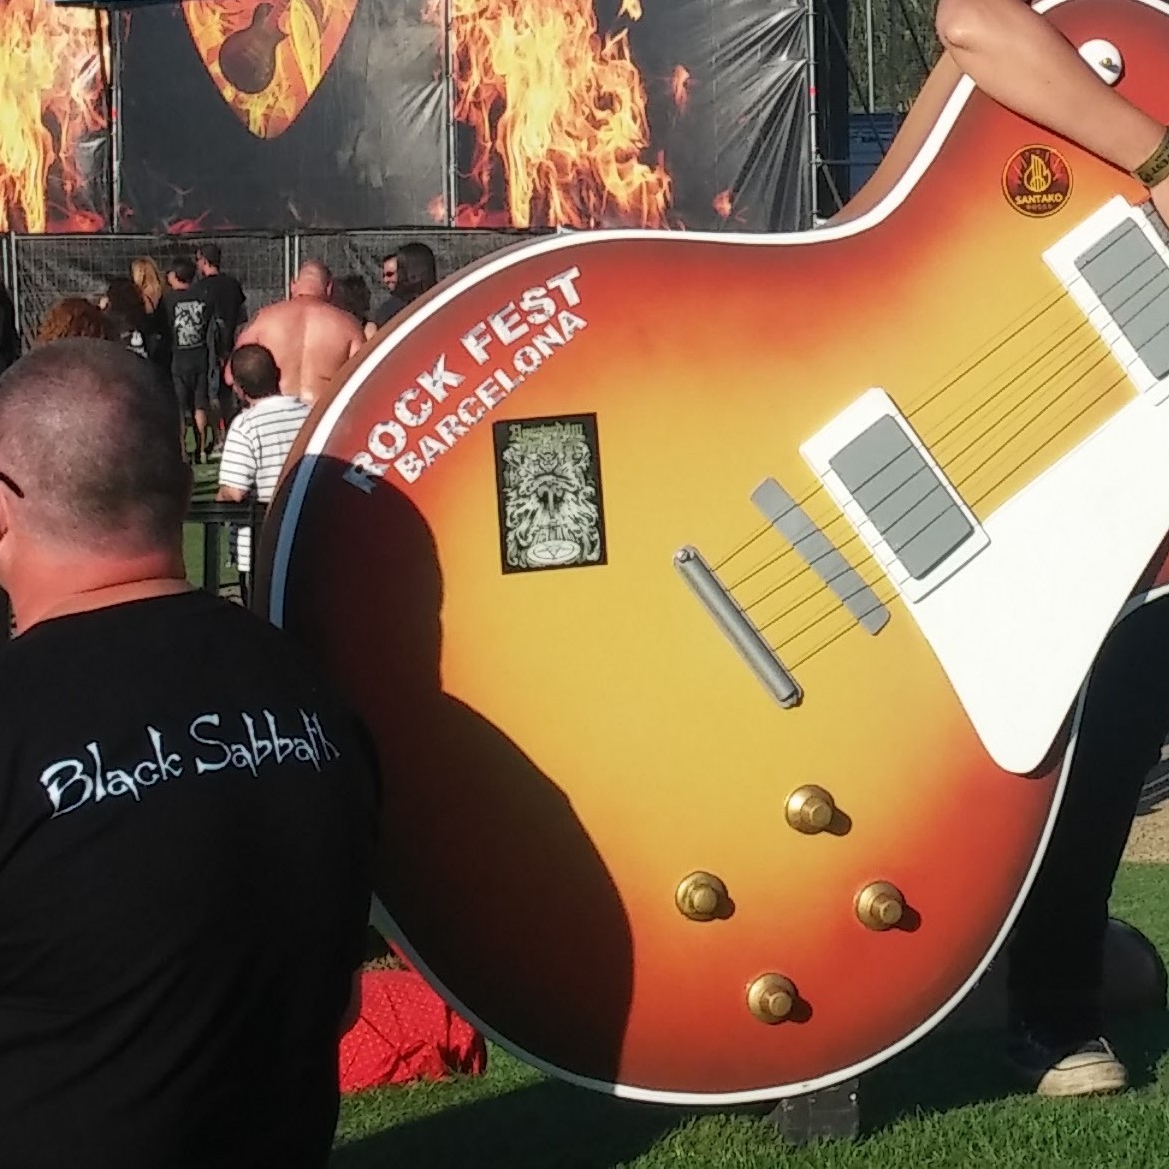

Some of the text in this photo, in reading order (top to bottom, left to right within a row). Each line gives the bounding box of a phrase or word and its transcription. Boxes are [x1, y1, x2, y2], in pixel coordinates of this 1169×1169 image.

[342, 266, 582, 494] ROCK FEST
[393, 309, 588, 484] BARCELONA
[39, 725, 184, 819] Black
